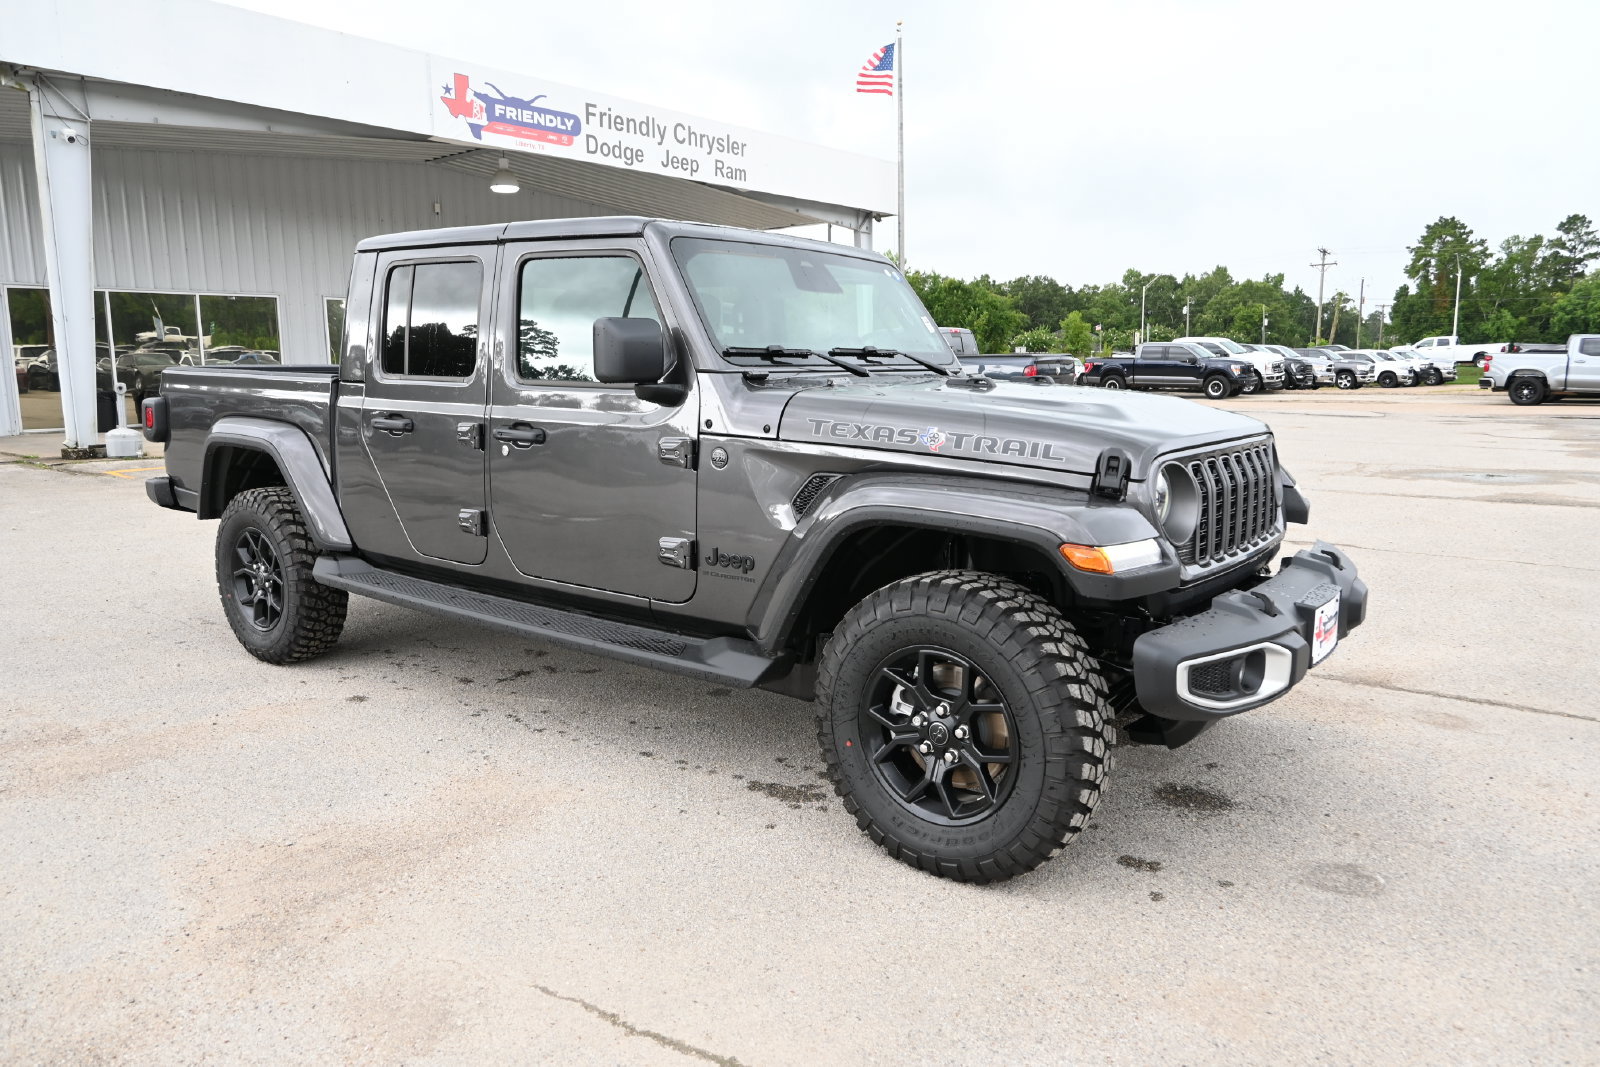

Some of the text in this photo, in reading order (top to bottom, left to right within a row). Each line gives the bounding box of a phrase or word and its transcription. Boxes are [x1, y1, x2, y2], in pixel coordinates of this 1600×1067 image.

[494, 103, 575, 131] FRIENDLY
[585, 102, 747, 157] Friendly Chrysler
[585, 134, 747, 182] Dodge Jeep Ram
[807, 418, 1066, 463] TEXAS TRAIL
[704, 546, 755, 575] Jeep
